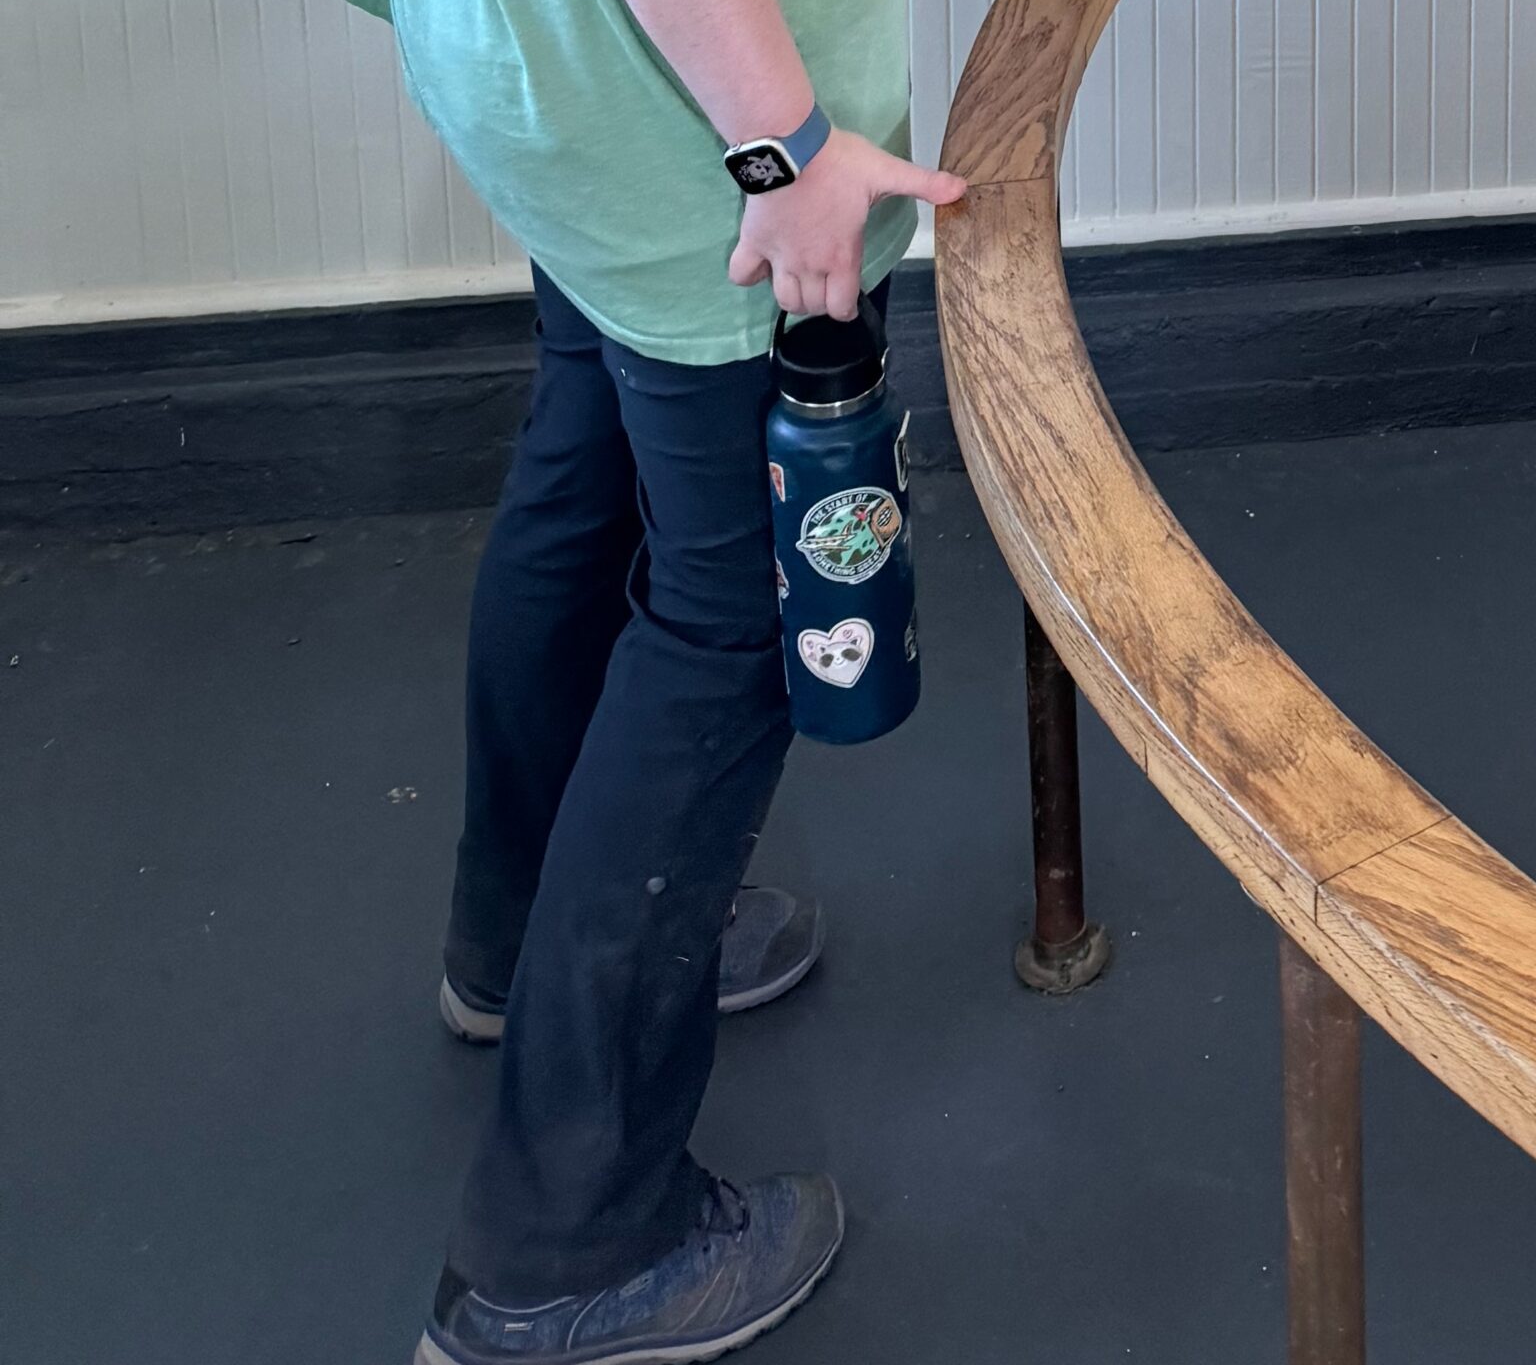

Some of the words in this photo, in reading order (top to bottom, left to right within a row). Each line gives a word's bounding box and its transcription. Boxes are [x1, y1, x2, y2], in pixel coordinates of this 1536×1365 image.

[810, 510, 826, 525] THE
[825, 496, 853, 512] START
[855, 493, 868, 504] OF
